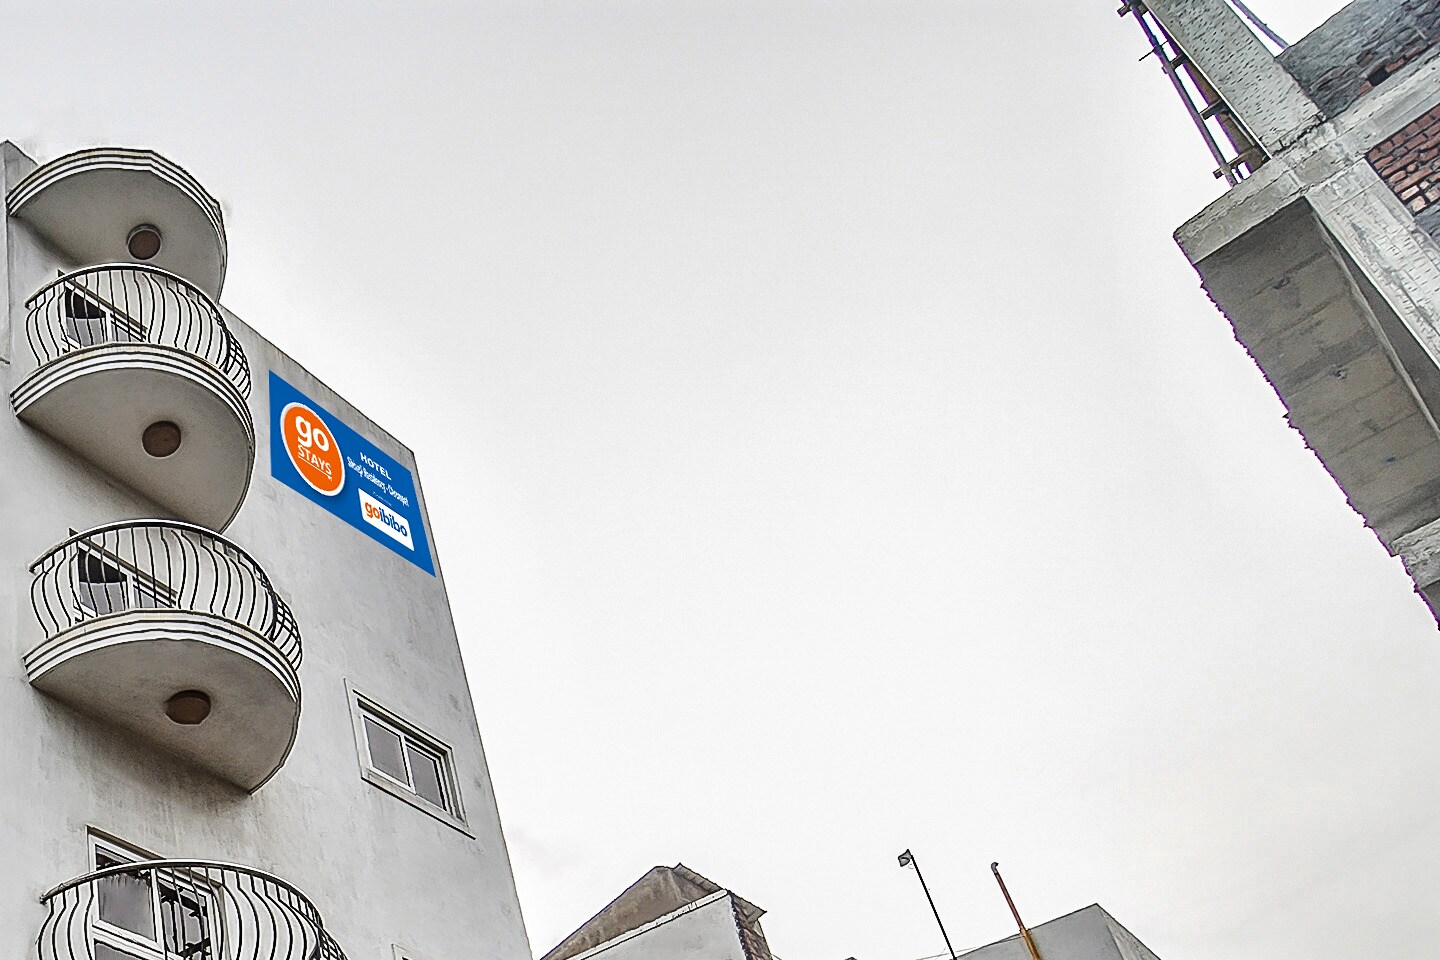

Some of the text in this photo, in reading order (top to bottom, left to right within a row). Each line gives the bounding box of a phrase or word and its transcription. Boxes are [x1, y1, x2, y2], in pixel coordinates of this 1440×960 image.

[295, 416, 329, 452] go
[298, 445, 332, 476] STAYS
[360, 451, 392, 481] HOTEL
[365, 501, 408, 538] goibibo
